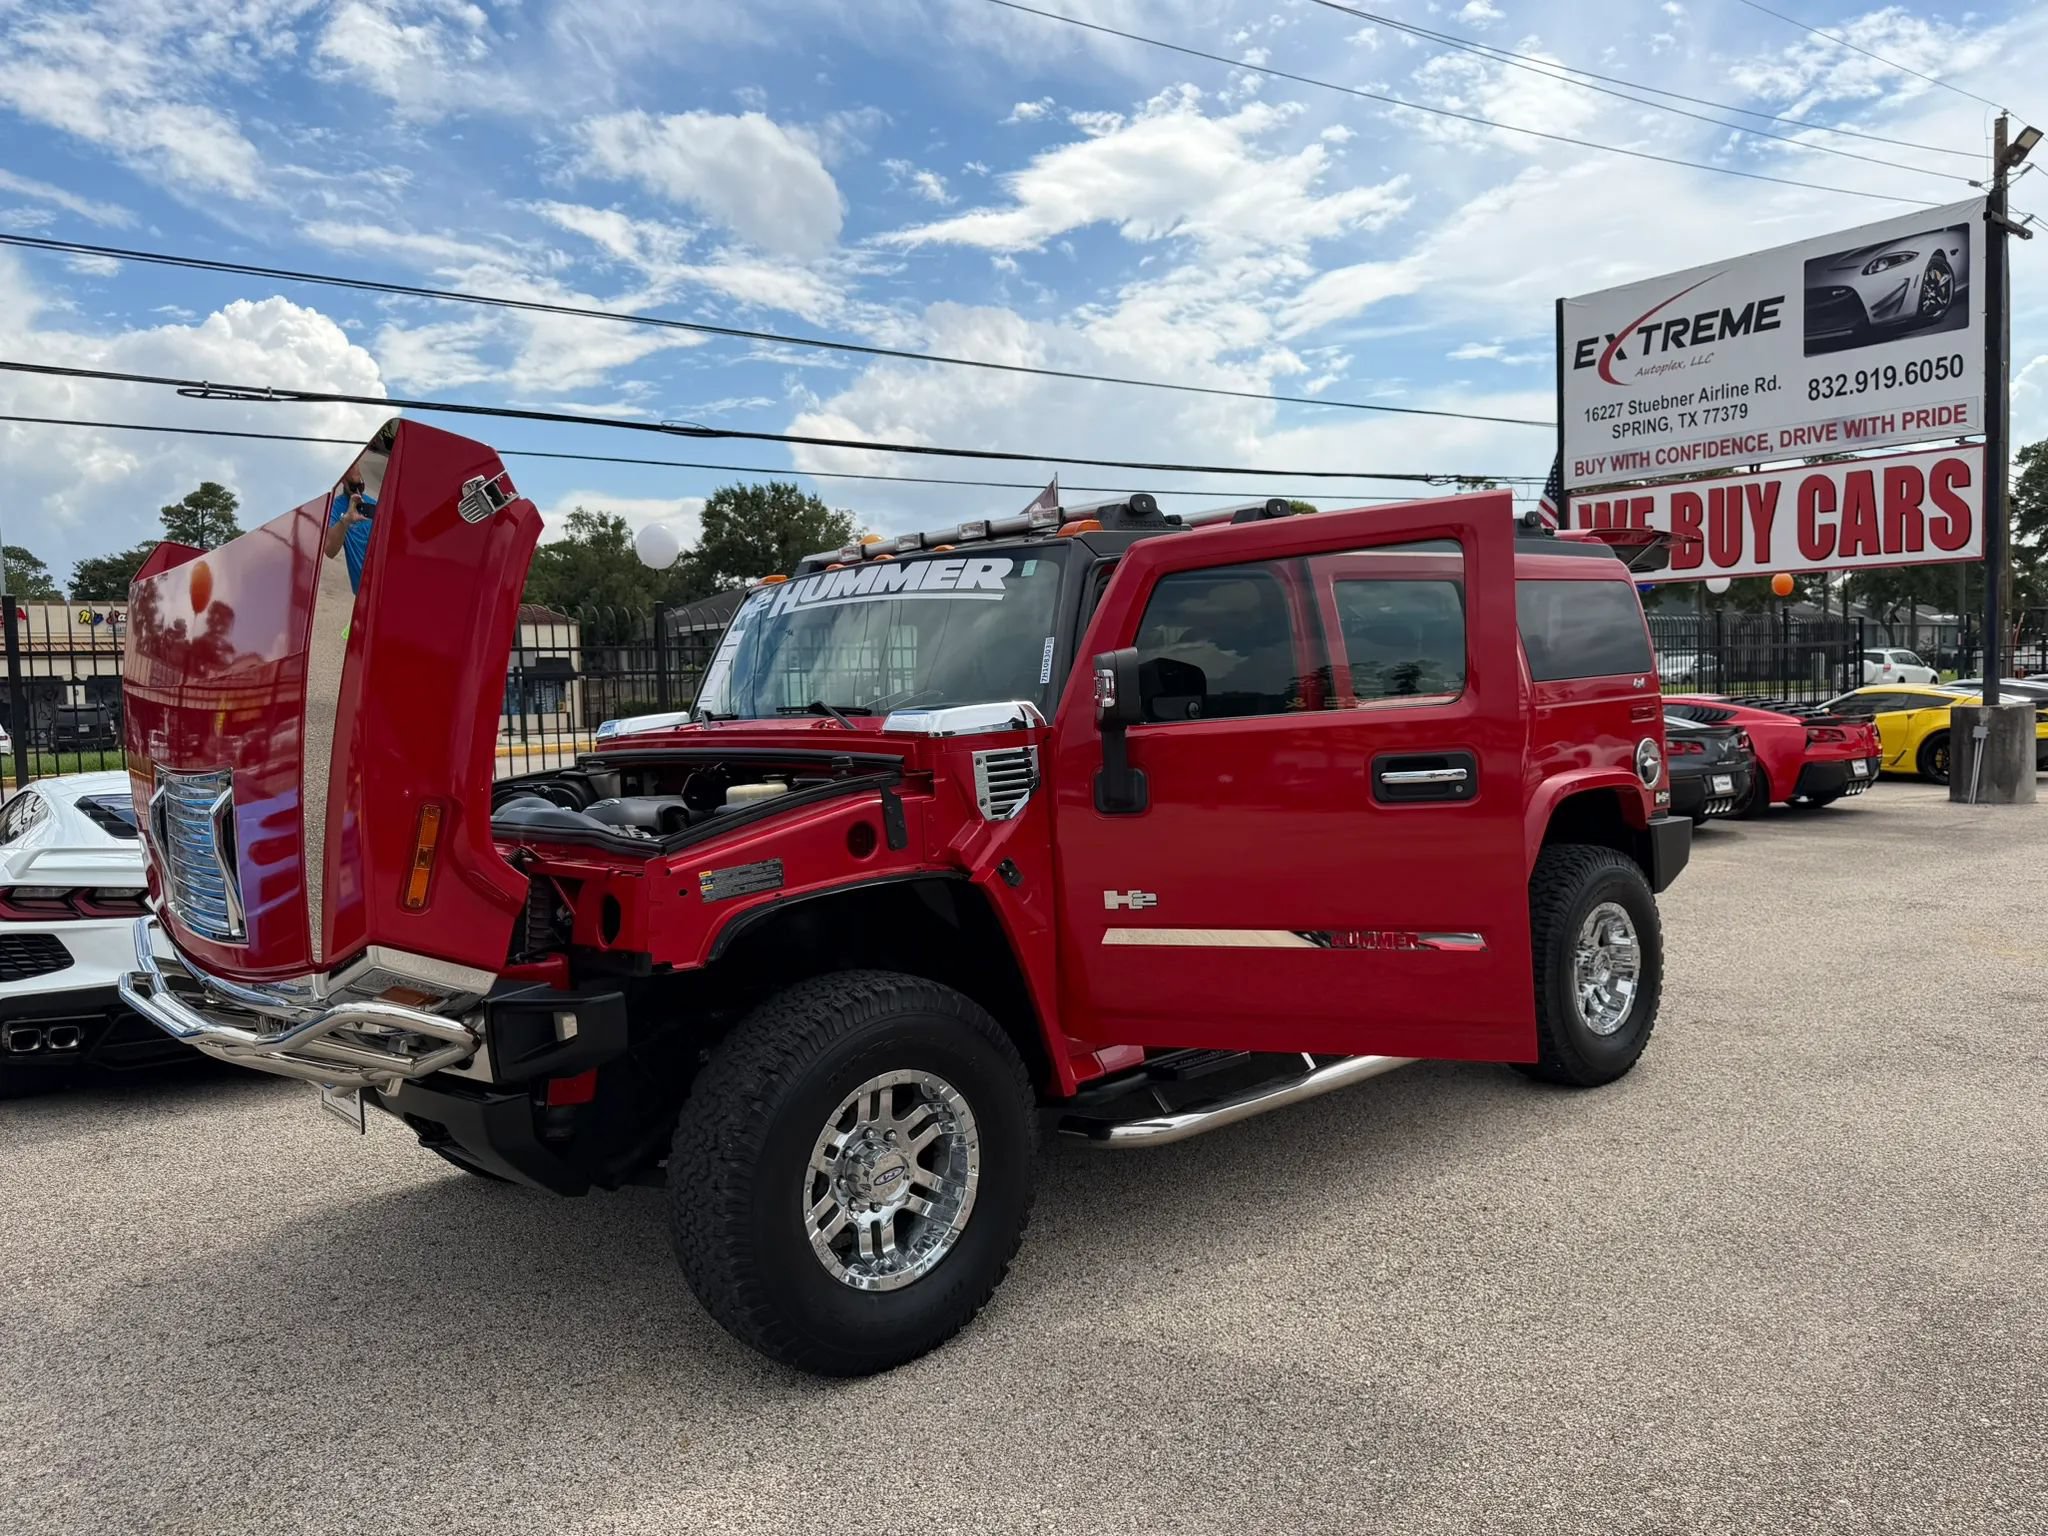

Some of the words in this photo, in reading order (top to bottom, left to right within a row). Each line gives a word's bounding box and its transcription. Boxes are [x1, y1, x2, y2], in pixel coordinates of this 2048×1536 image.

[1573, 295, 1785, 370] EXTREME
[1635, 358, 1686, 377] Autoplex,
[1690, 352, 1715, 366] LLC
[1808, 354, 1964, 401] 832.919.6050
[1584, 402, 1623, 422] 16227
[1628, 393, 1695, 415] Stuebner
[1698, 382, 1749, 403] Airline
[1754, 375, 1781, 394] Rd.
[1612, 416, 1673, 439] SPRING,
[1678, 411, 1698, 429] TX
[1703, 403, 1748, 425] 77379
[1575, 457, 1607, 477] BUY
[1610, 450, 1650, 472] WITH
[1655, 433, 1774, 467] CONFIDENCE,
[1780, 422, 1838, 448] DRIVE
[1843, 414, 1895, 439] WITH
[1902, 403, 1967, 431] PRIDE
[1671, 480, 1781, 570] BUY
[1797, 458, 1972, 561] CARS
[766, 558, 1014, 619] HUMMER
[1104, 890, 1157, 909] H2
[1331, 931, 1419, 949] HUMMER
